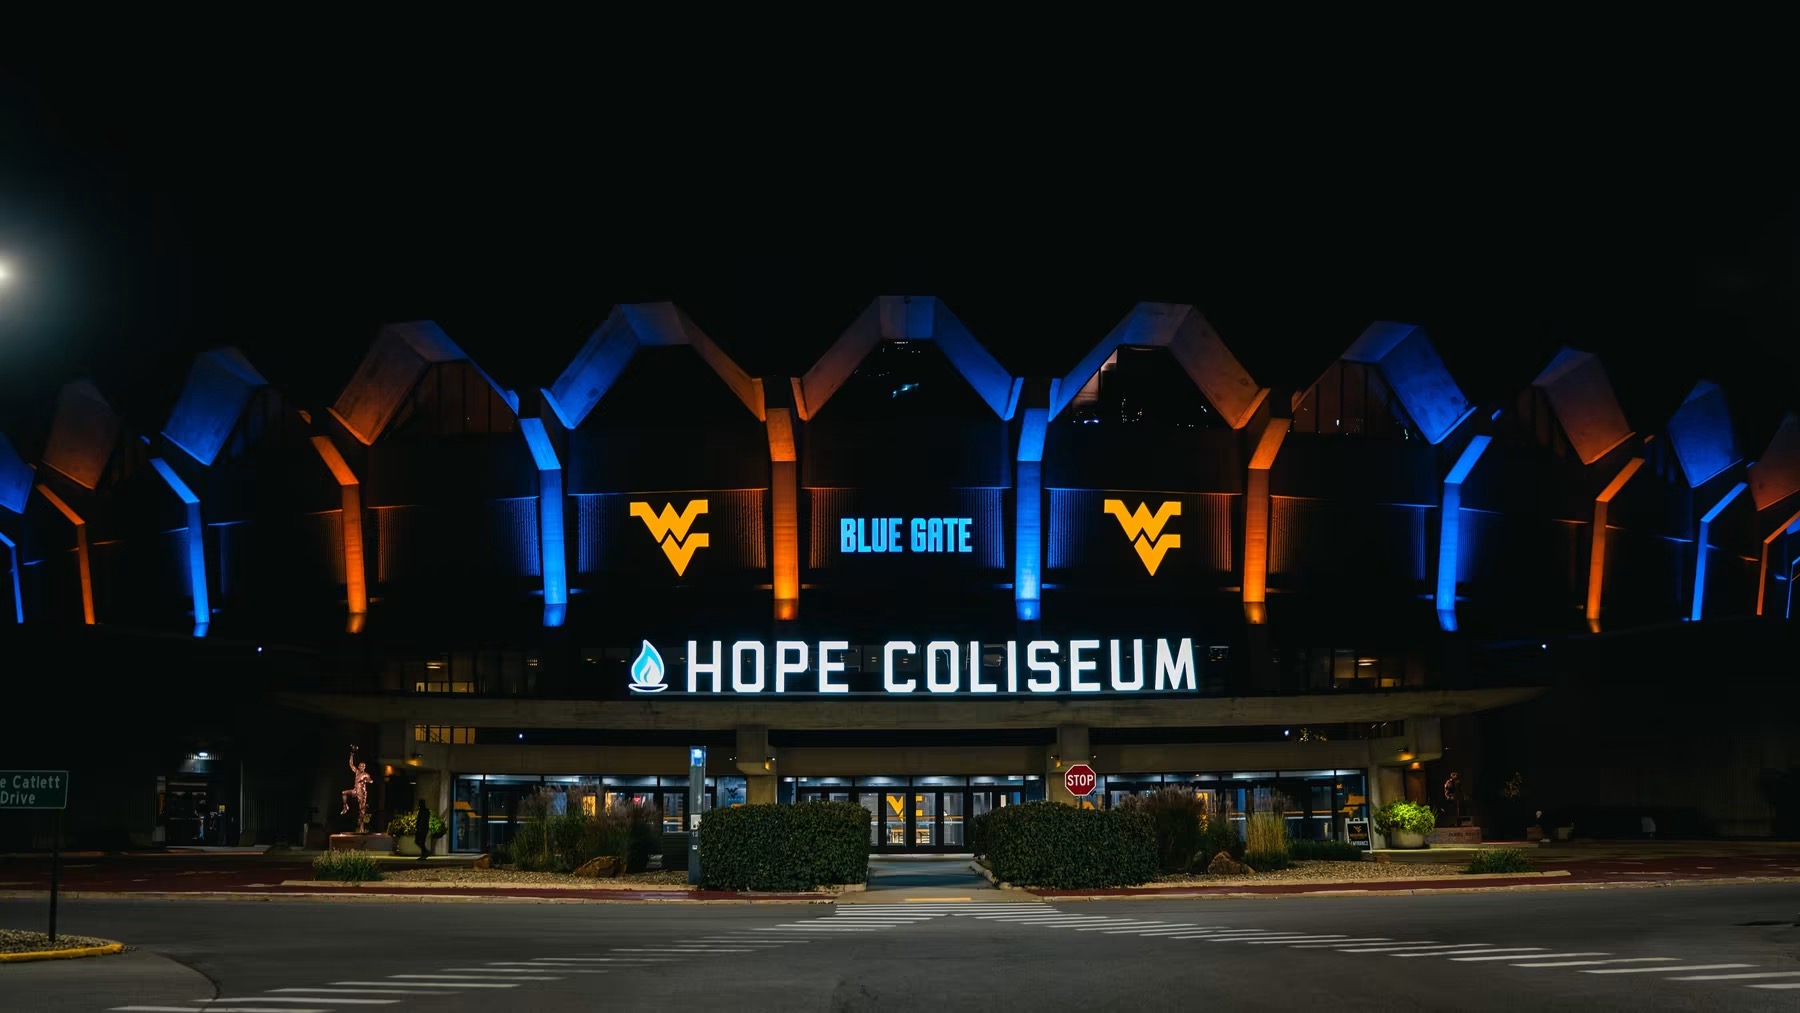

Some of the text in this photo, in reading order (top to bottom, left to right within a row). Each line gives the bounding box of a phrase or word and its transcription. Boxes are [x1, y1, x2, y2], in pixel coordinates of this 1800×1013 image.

[840, 517, 973, 553] BLUE GATE
[687, 638, 1197, 693] HOPE COLISEUM
[12, 775, 61, 789] Catlett
[1067, 774, 1094, 786] STOP
[0, 790, 36, 806] Drive
